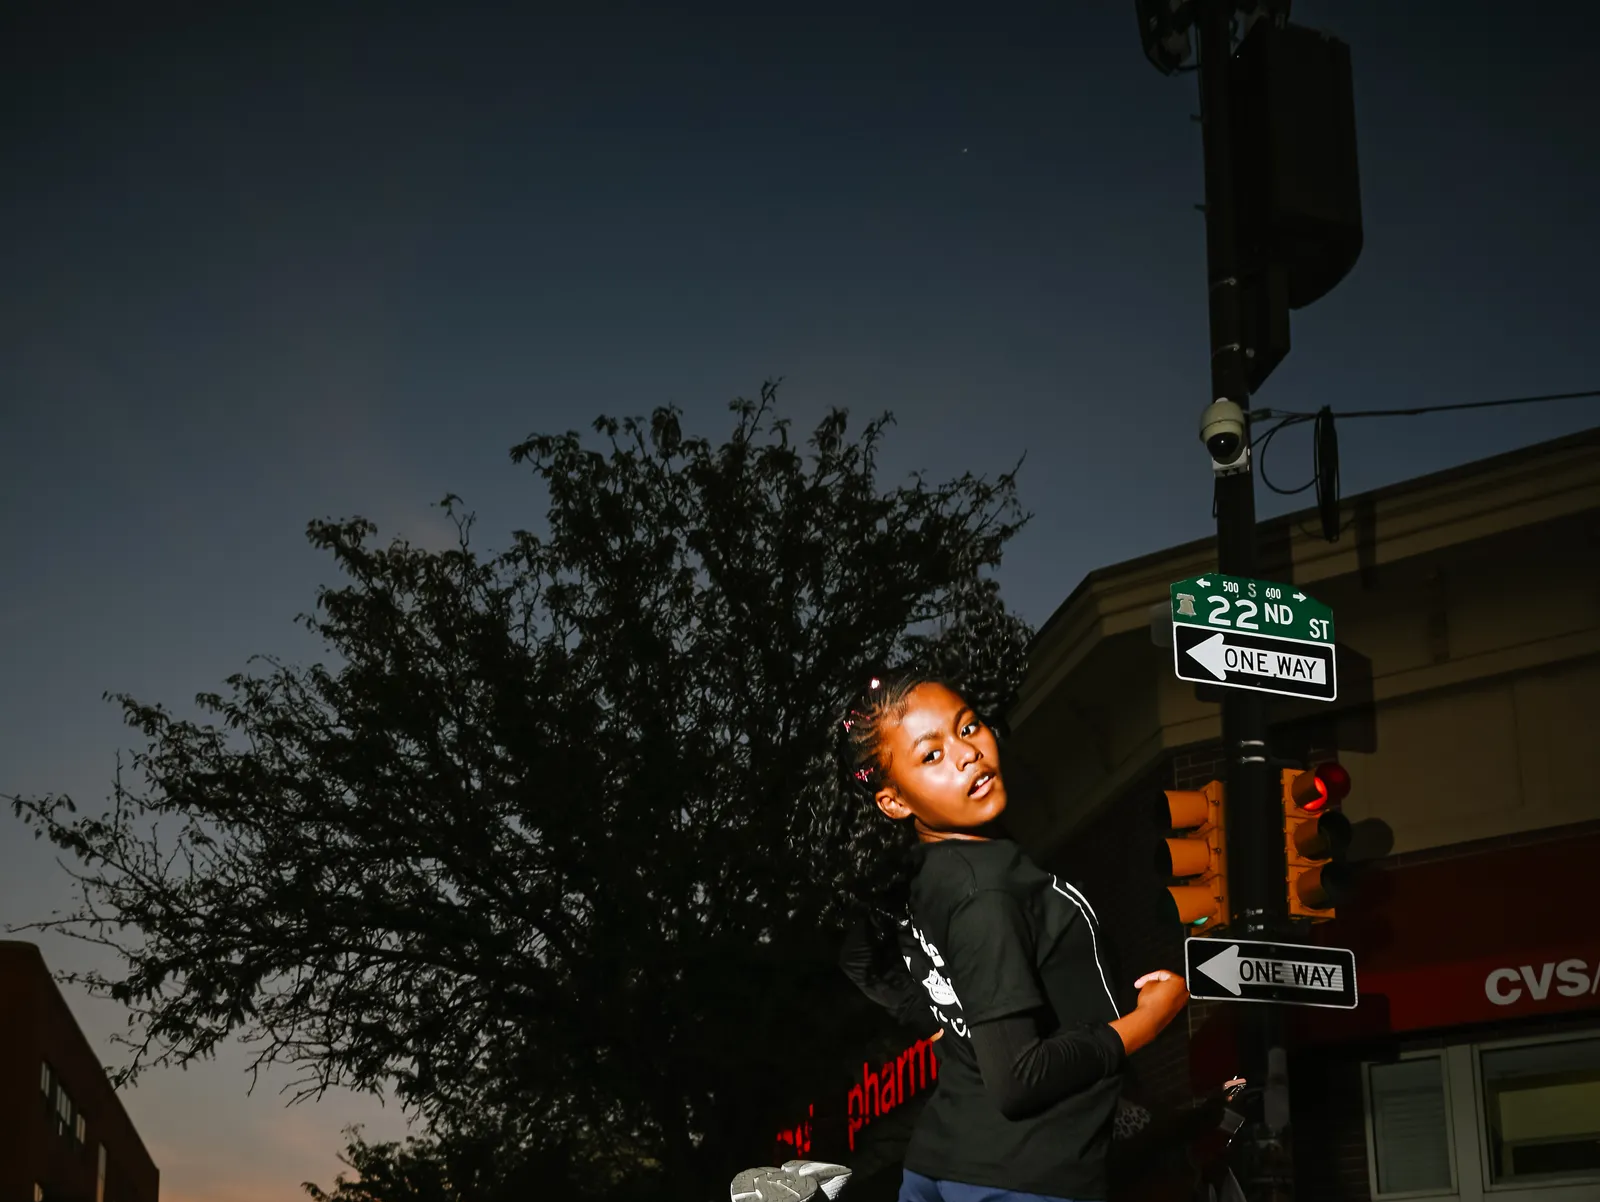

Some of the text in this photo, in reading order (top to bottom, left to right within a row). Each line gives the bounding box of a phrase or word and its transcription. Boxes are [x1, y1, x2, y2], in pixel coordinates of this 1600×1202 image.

[1222, 580, 1282, 600] 500 S 600
[1308, 617, 1330, 640] ST
[1224, 648, 1317, 680] ONE WAY
[1239, 959, 1337, 988] ONE WAY
